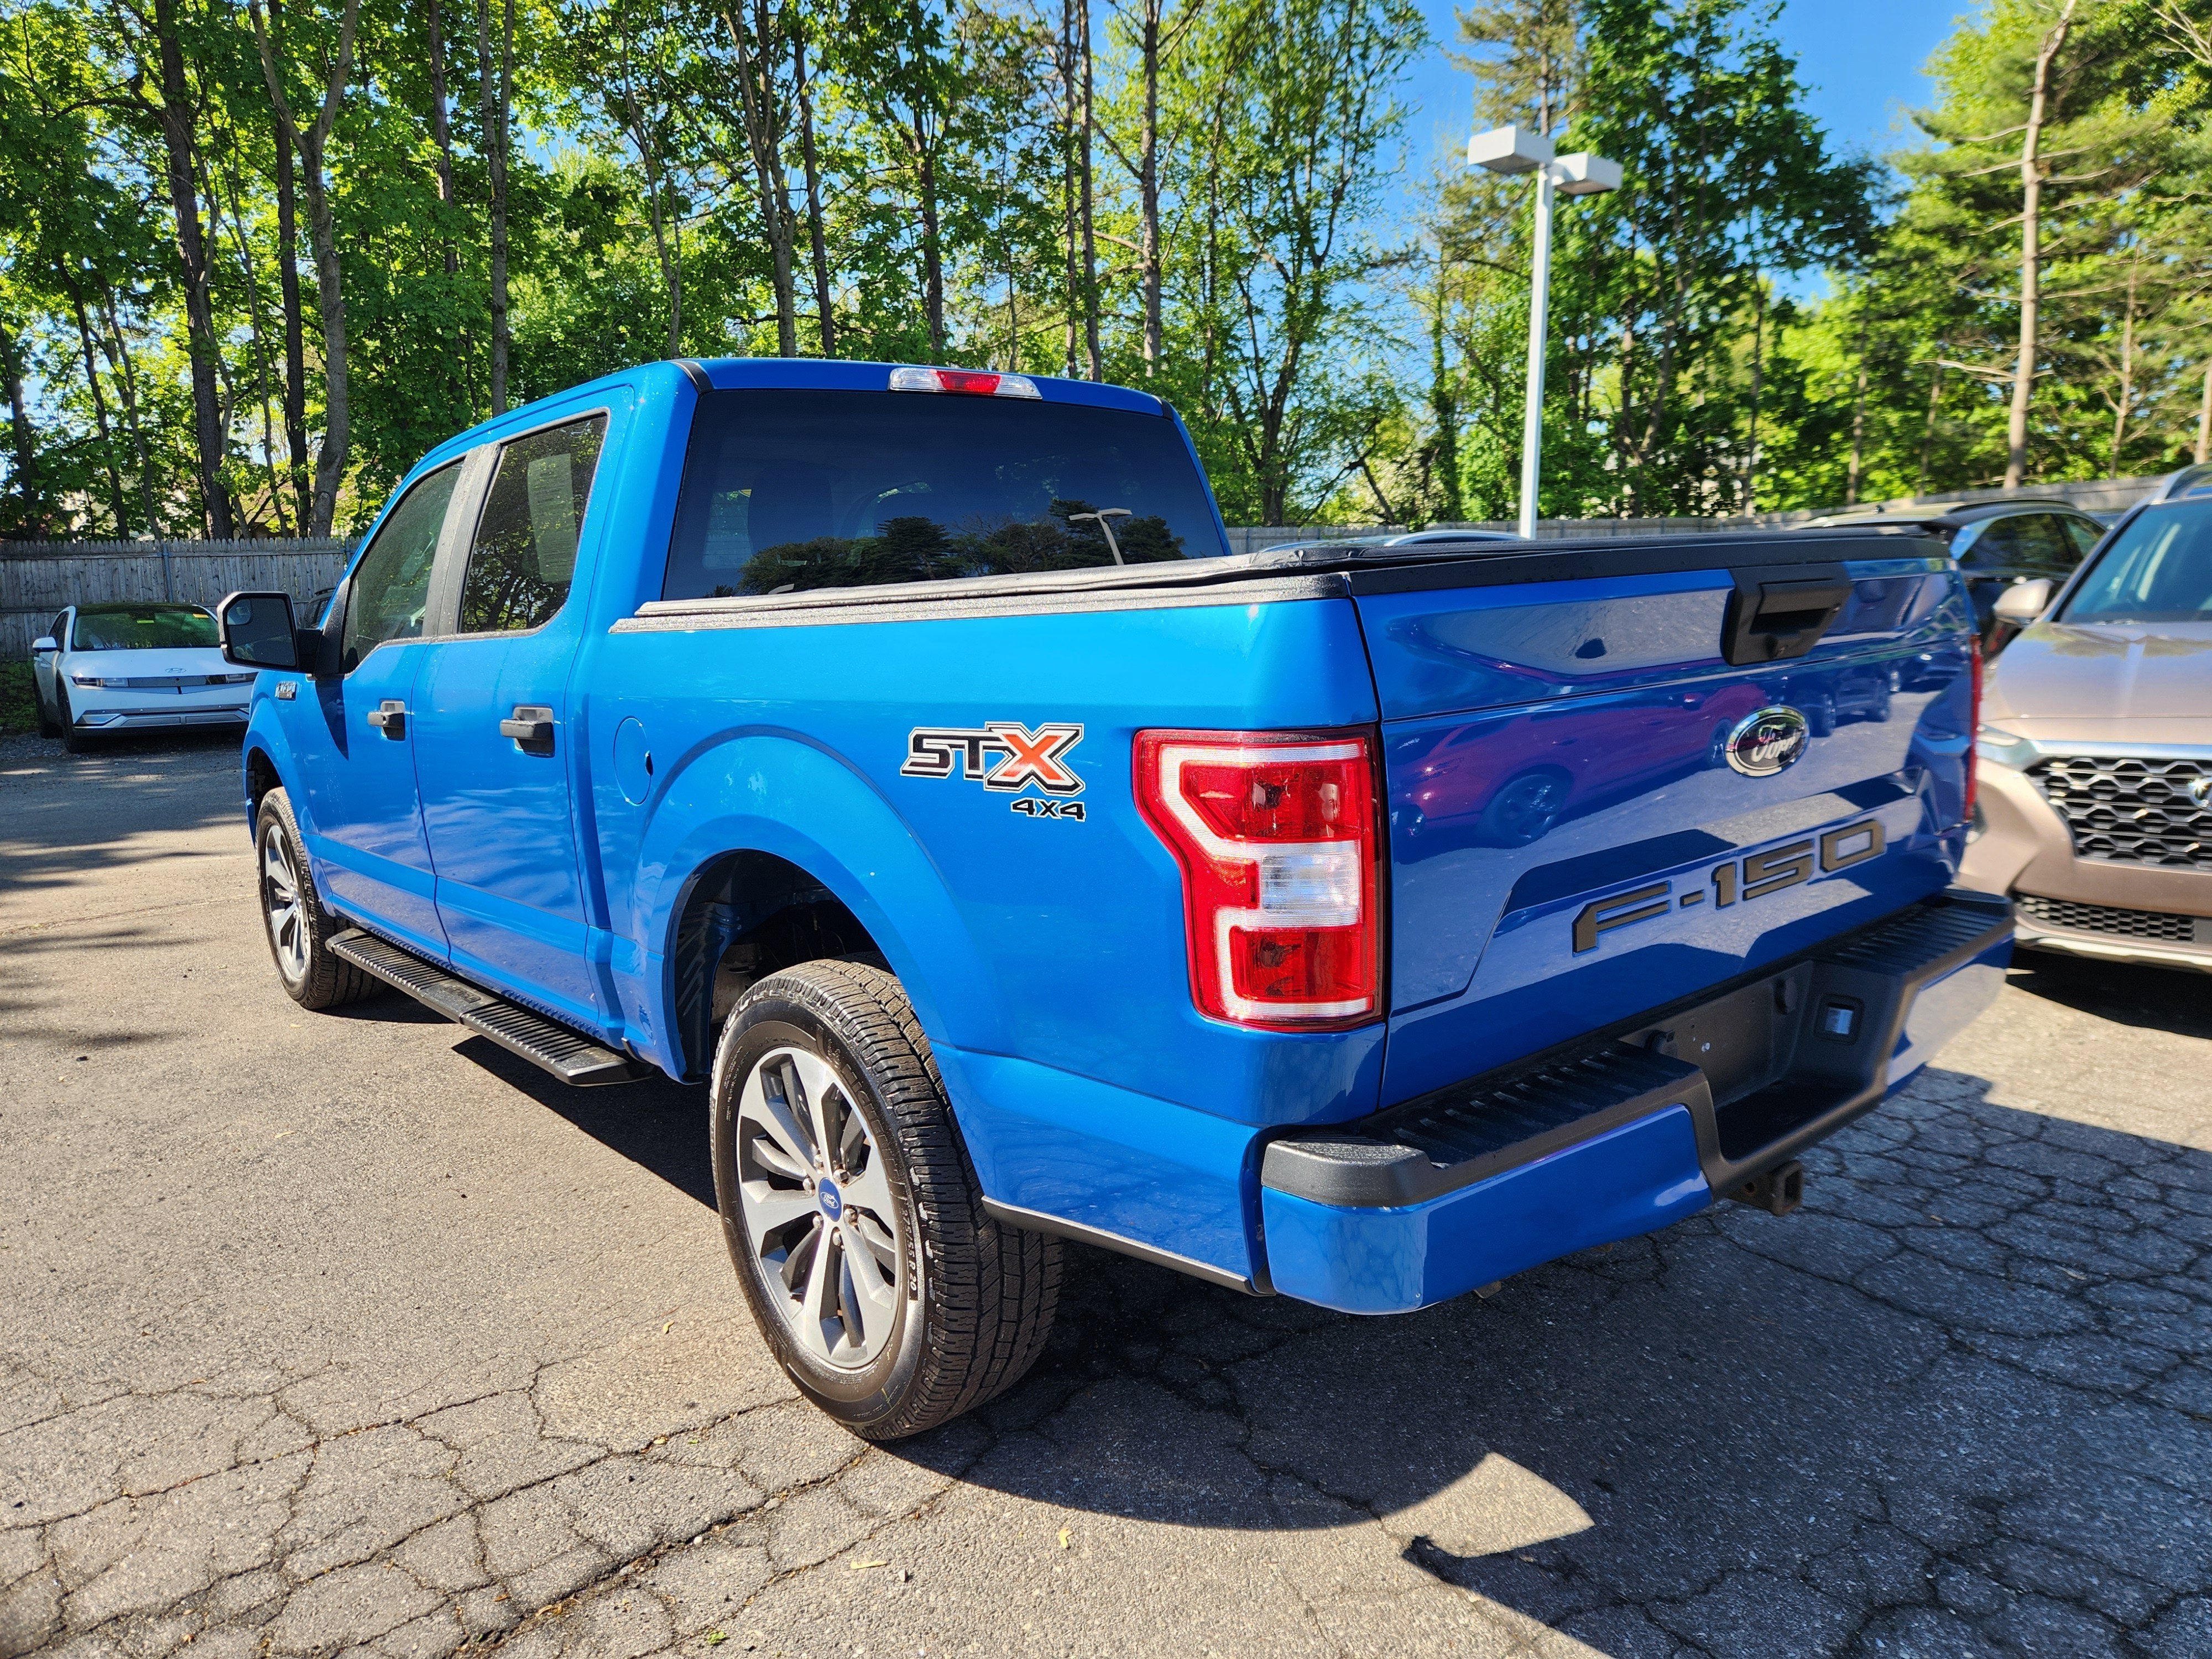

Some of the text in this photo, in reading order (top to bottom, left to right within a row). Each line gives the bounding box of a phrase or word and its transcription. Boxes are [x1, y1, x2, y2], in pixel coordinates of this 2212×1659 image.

[1750, 723, 1803, 763] Ford
[900, 721, 1086, 797] STX
[1572, 818, 1885, 957] F-150
[822, 1193, 836, 1207] Ford
[909, 1260, 916, 1271] R
[909, 1272, 917, 1291] 20
